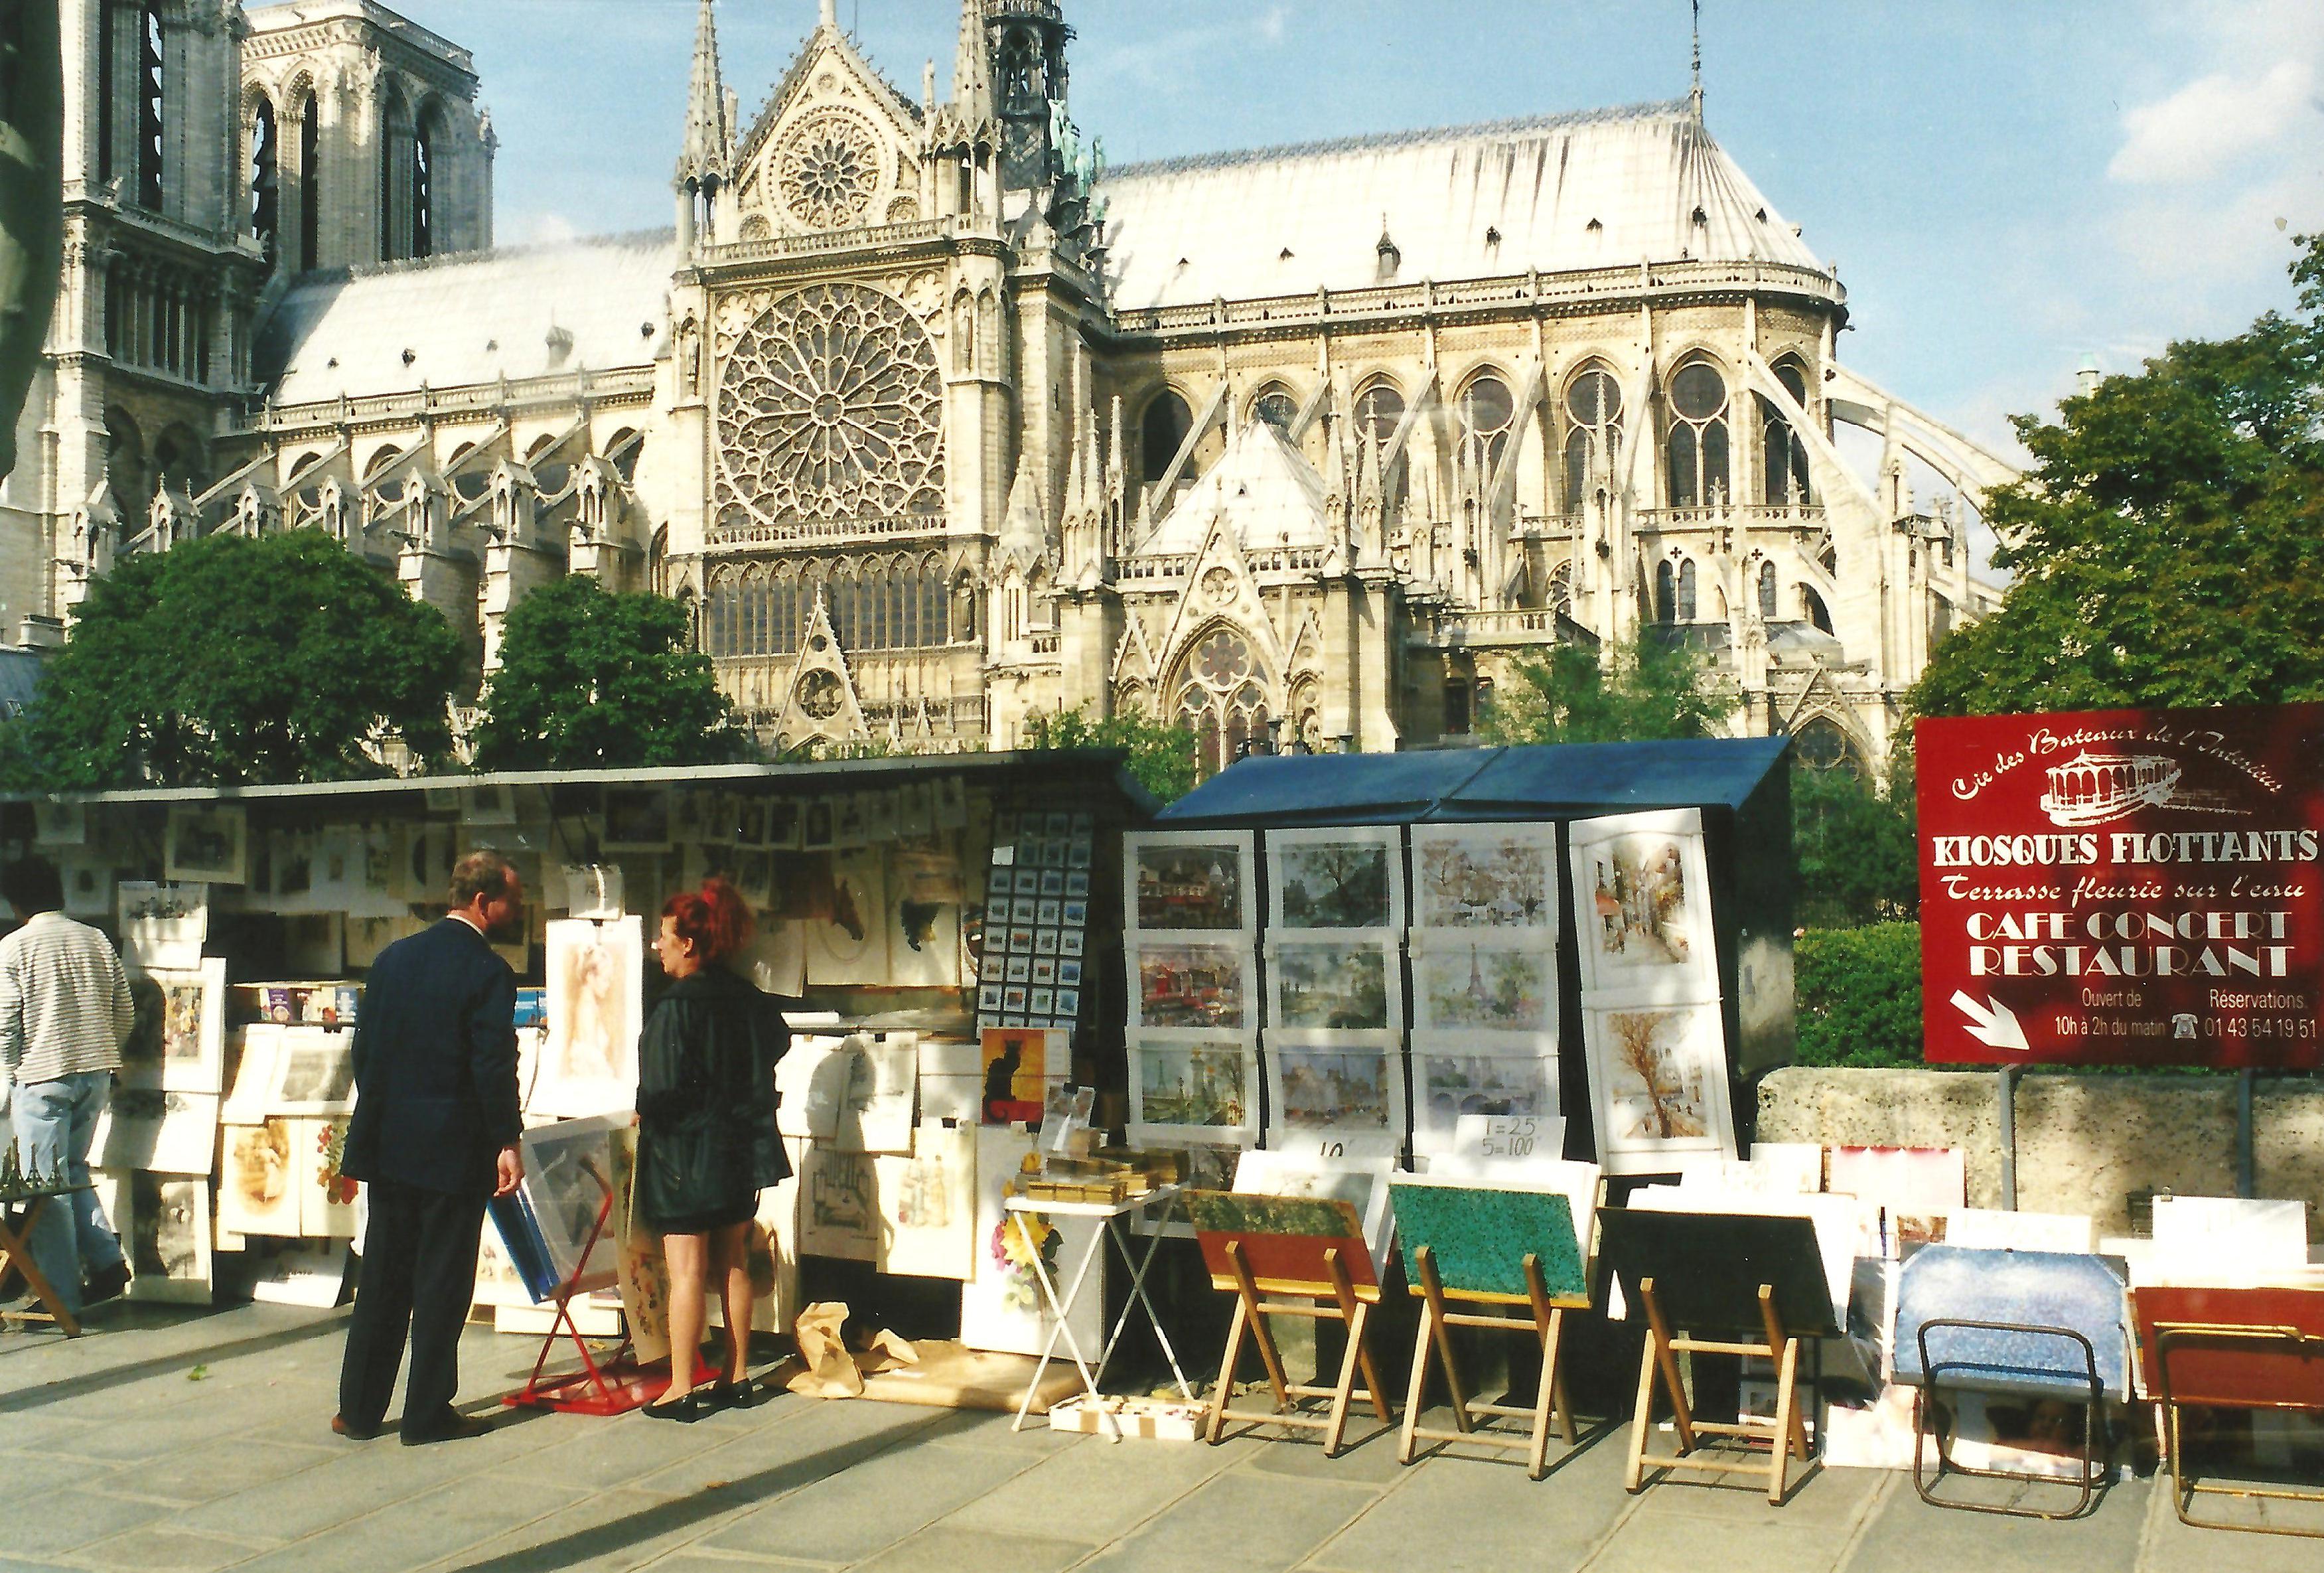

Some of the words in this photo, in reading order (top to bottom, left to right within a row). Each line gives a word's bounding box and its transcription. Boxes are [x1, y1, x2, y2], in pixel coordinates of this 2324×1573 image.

[1952, 771, 1993, 800] Cie
[1995, 752, 2024, 774] des
[2027, 727, 2138, 755] Bateaux
[2145, 724, 2173, 743] de
[1932, 833, 2098, 867] KIOSQUES
[2109, 829, 2319, 863] FLOTTANTS
[1940, 872, 2062, 901] Terrasse
[2071, 875, 2162, 909] fleurie
[2174, 883, 2219, 898] sur
[2230, 874, 2306, 898] l'eau
[1966, 911, 2076, 941] CAFE
[2086, 911, 2293, 940] CONCERT
[1970, 944, 2295, 978] RESTAURANT
[2082, 986, 2123, 1008] Ouvert
[2126, 988, 2142, 1008] de
[2055, 1015, 2077, 1035] 10h
[2080, 1015, 2088, 1035] à
[2092, 1015, 2108, 1035] 2h
[2112, 1016, 2128, 1036] du
[2131, 1019, 2167, 1036] matin
[2205, 1017, 2222, 1037] 01
[2227, 1017, 2248, 1037] 43
[2252, 1017, 2272, 1037] 54
[2276, 1018, 2294, 1038] 19
[2299, 1018, 2316, 1039] 51
